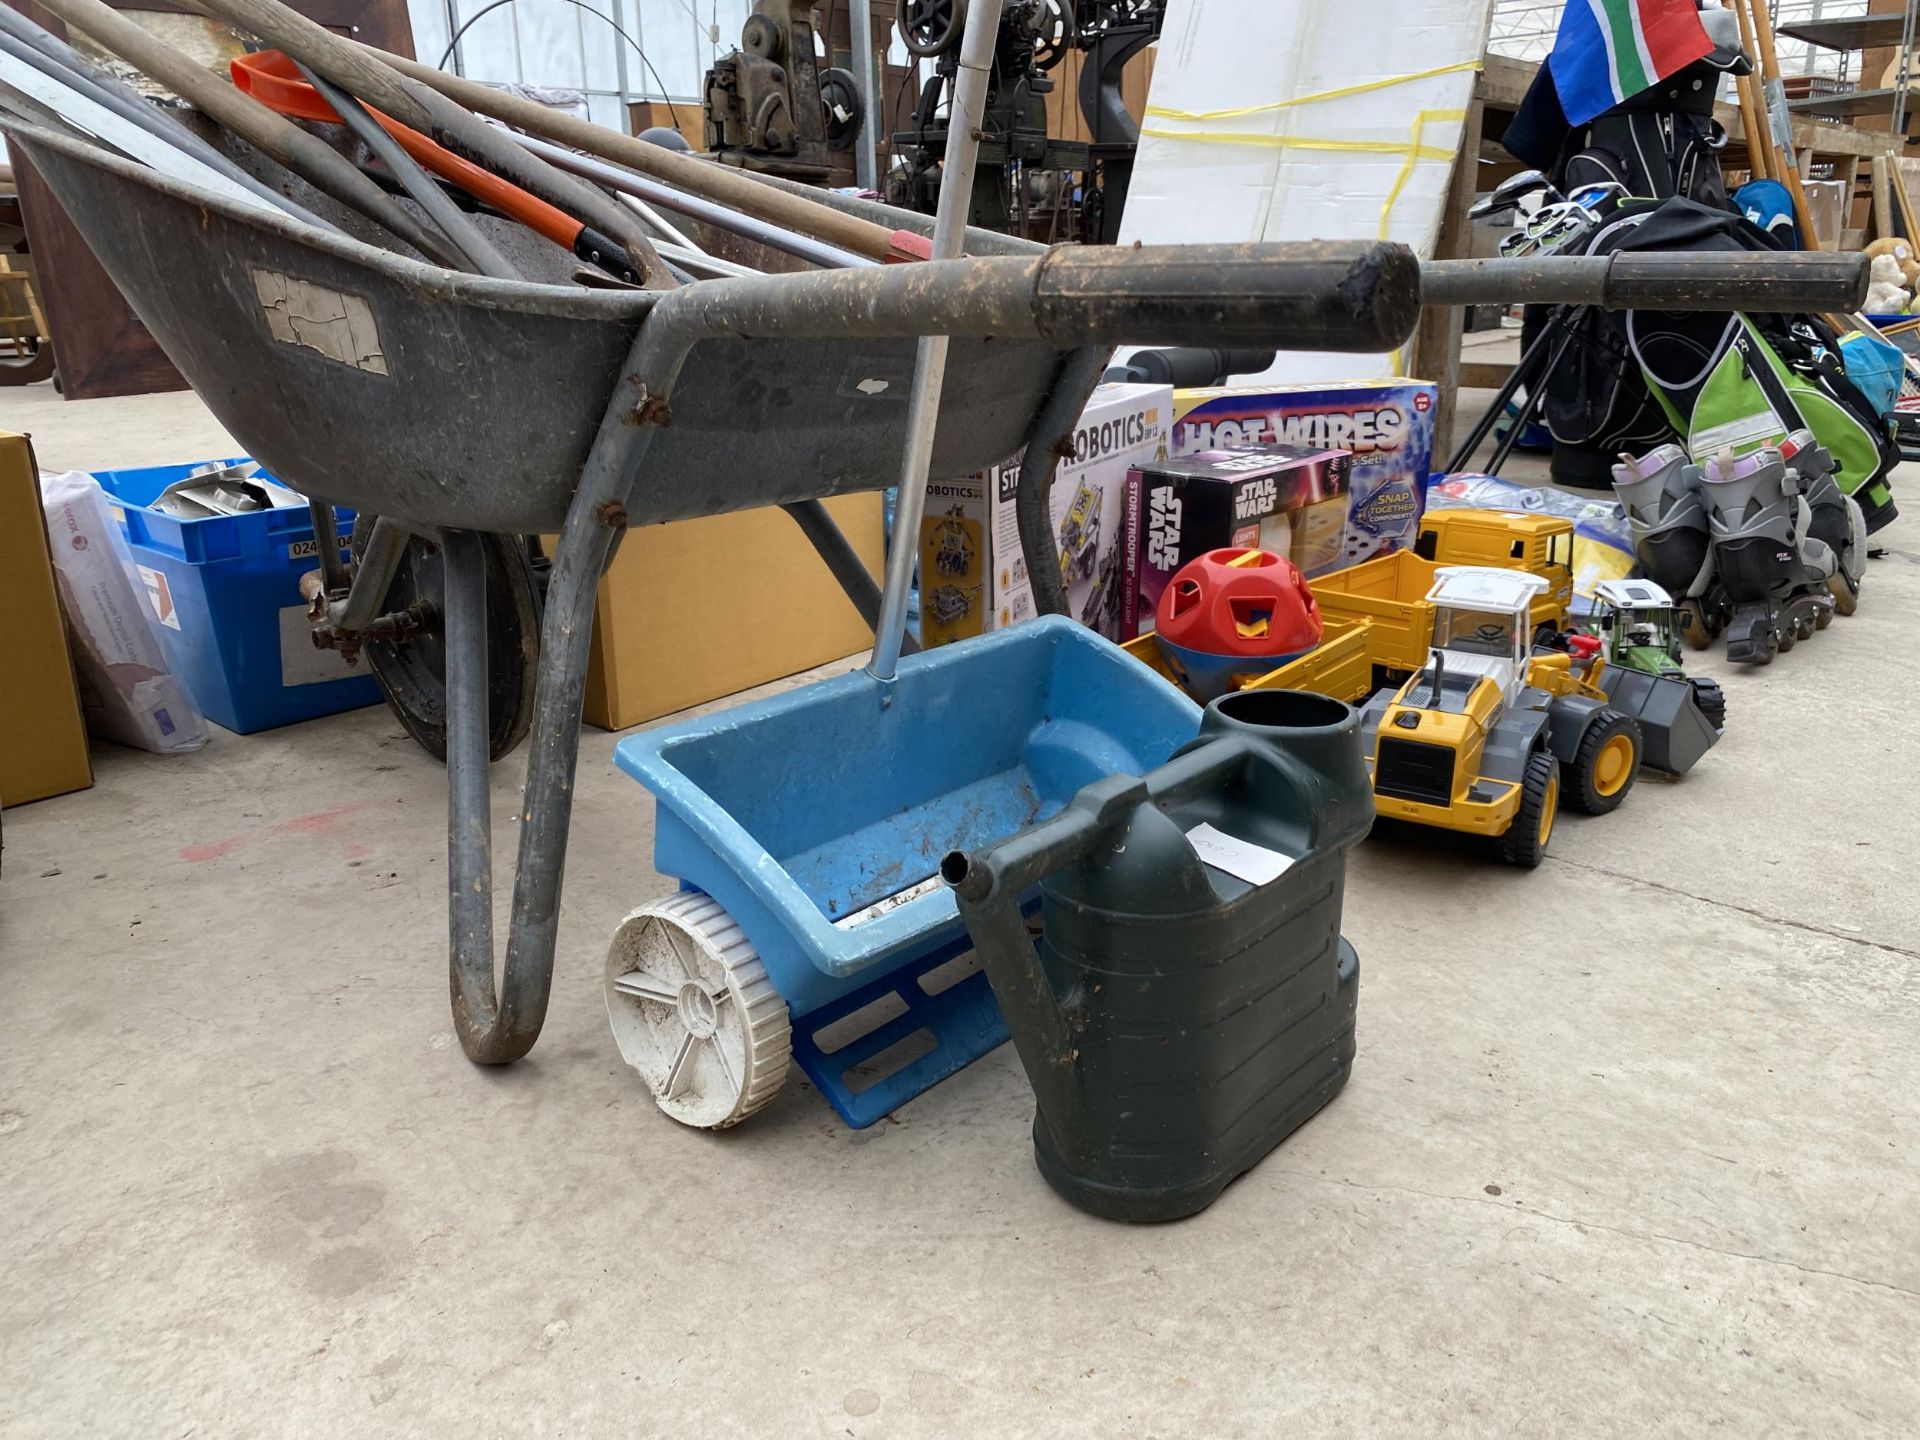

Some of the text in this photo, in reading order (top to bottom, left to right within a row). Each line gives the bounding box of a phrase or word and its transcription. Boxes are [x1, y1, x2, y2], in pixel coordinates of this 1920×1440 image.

[1063, 411, 1145, 467] OBOTICS
[1183, 408, 1401, 455] HOT WIRES
[926, 485, 973, 498] OBOTICS
[1235, 478, 1277, 504] STAR
[1235, 494, 1277, 520] WARS
[1369, 503, 1415, 514] TOGETHER
[1377, 492, 1409, 505] SNAP
[1126, 481, 1138, 572] STORMTROOPER
[1148, 485, 1167, 571] WARS
[1163, 485, 1182, 572] STAR
